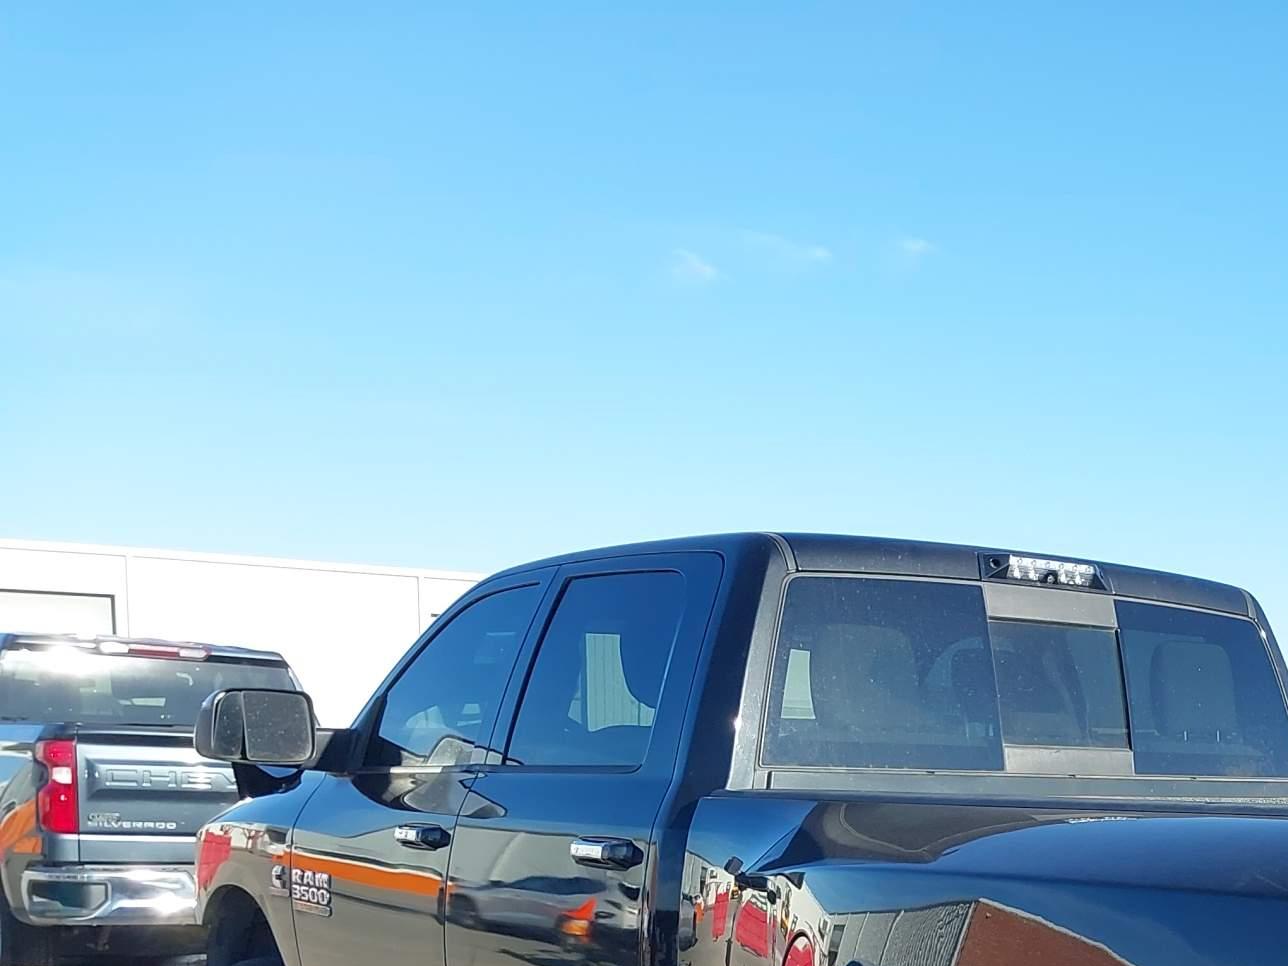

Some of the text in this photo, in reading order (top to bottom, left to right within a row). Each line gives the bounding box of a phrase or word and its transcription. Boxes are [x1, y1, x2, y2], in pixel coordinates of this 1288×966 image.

[87, 818, 177, 830] SILVERADO
[291, 867, 330, 888] RAM
[291, 884, 331, 906] 3500
